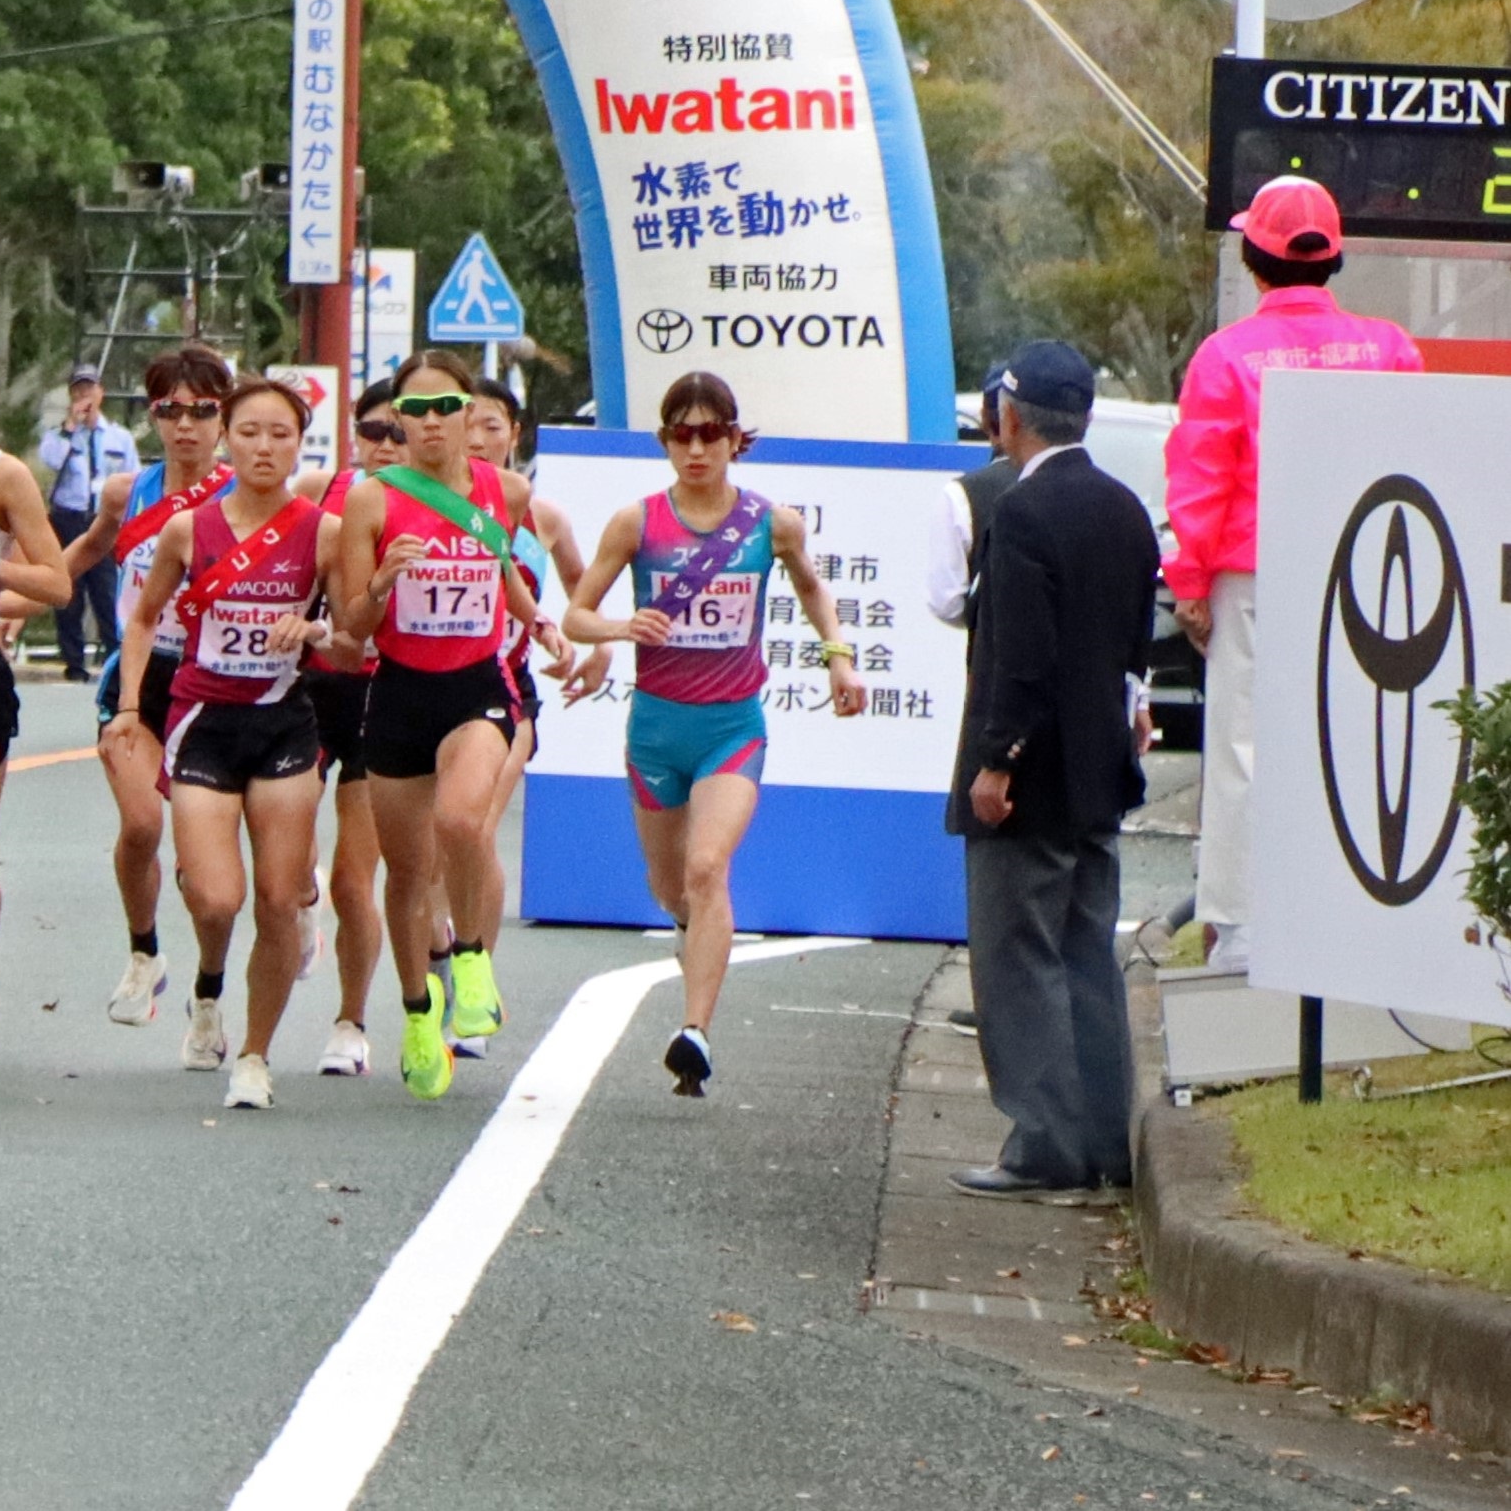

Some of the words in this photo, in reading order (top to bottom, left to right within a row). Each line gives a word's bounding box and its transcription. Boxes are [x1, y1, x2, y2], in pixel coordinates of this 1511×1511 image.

[663, 34, 794, 63] 特別協賛
[594, 74, 856, 135] Iwatani
[1263, 70, 1511, 126] CITIZEN
[632, 161, 743, 207] 水素で
[632, 190, 862, 252] 世界を動かせ。
[708, 264, 839, 292] 車両協力
[702, 314, 885, 348] TOYOTA
[228, 580, 301, 598] WACOAL
[423, 585, 491, 616] 17-1
